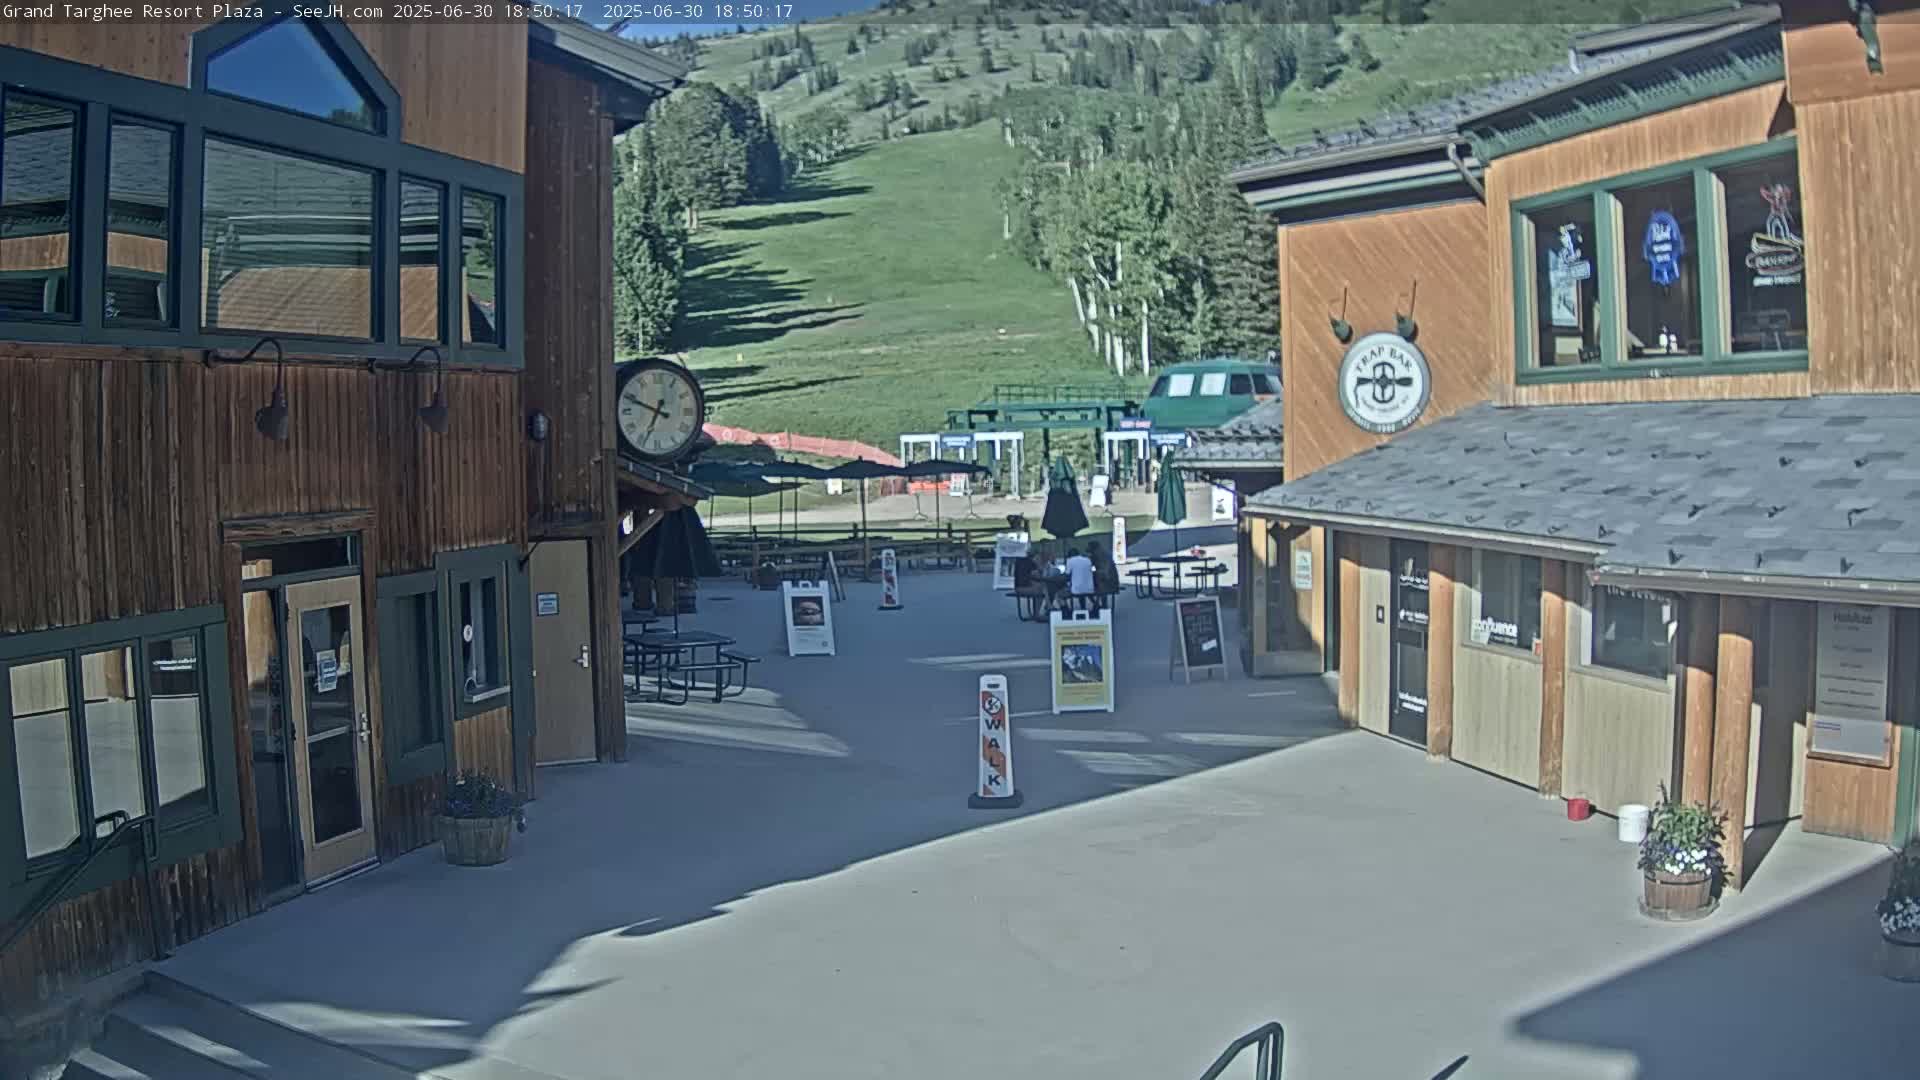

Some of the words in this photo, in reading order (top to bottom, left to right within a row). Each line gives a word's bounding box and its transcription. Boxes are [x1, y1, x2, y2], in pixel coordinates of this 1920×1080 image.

[1355, 346, 1385, 373] TRAP
[1389, 347, 1413, 372] BAR
[984, 718, 1002, 787] WALK
